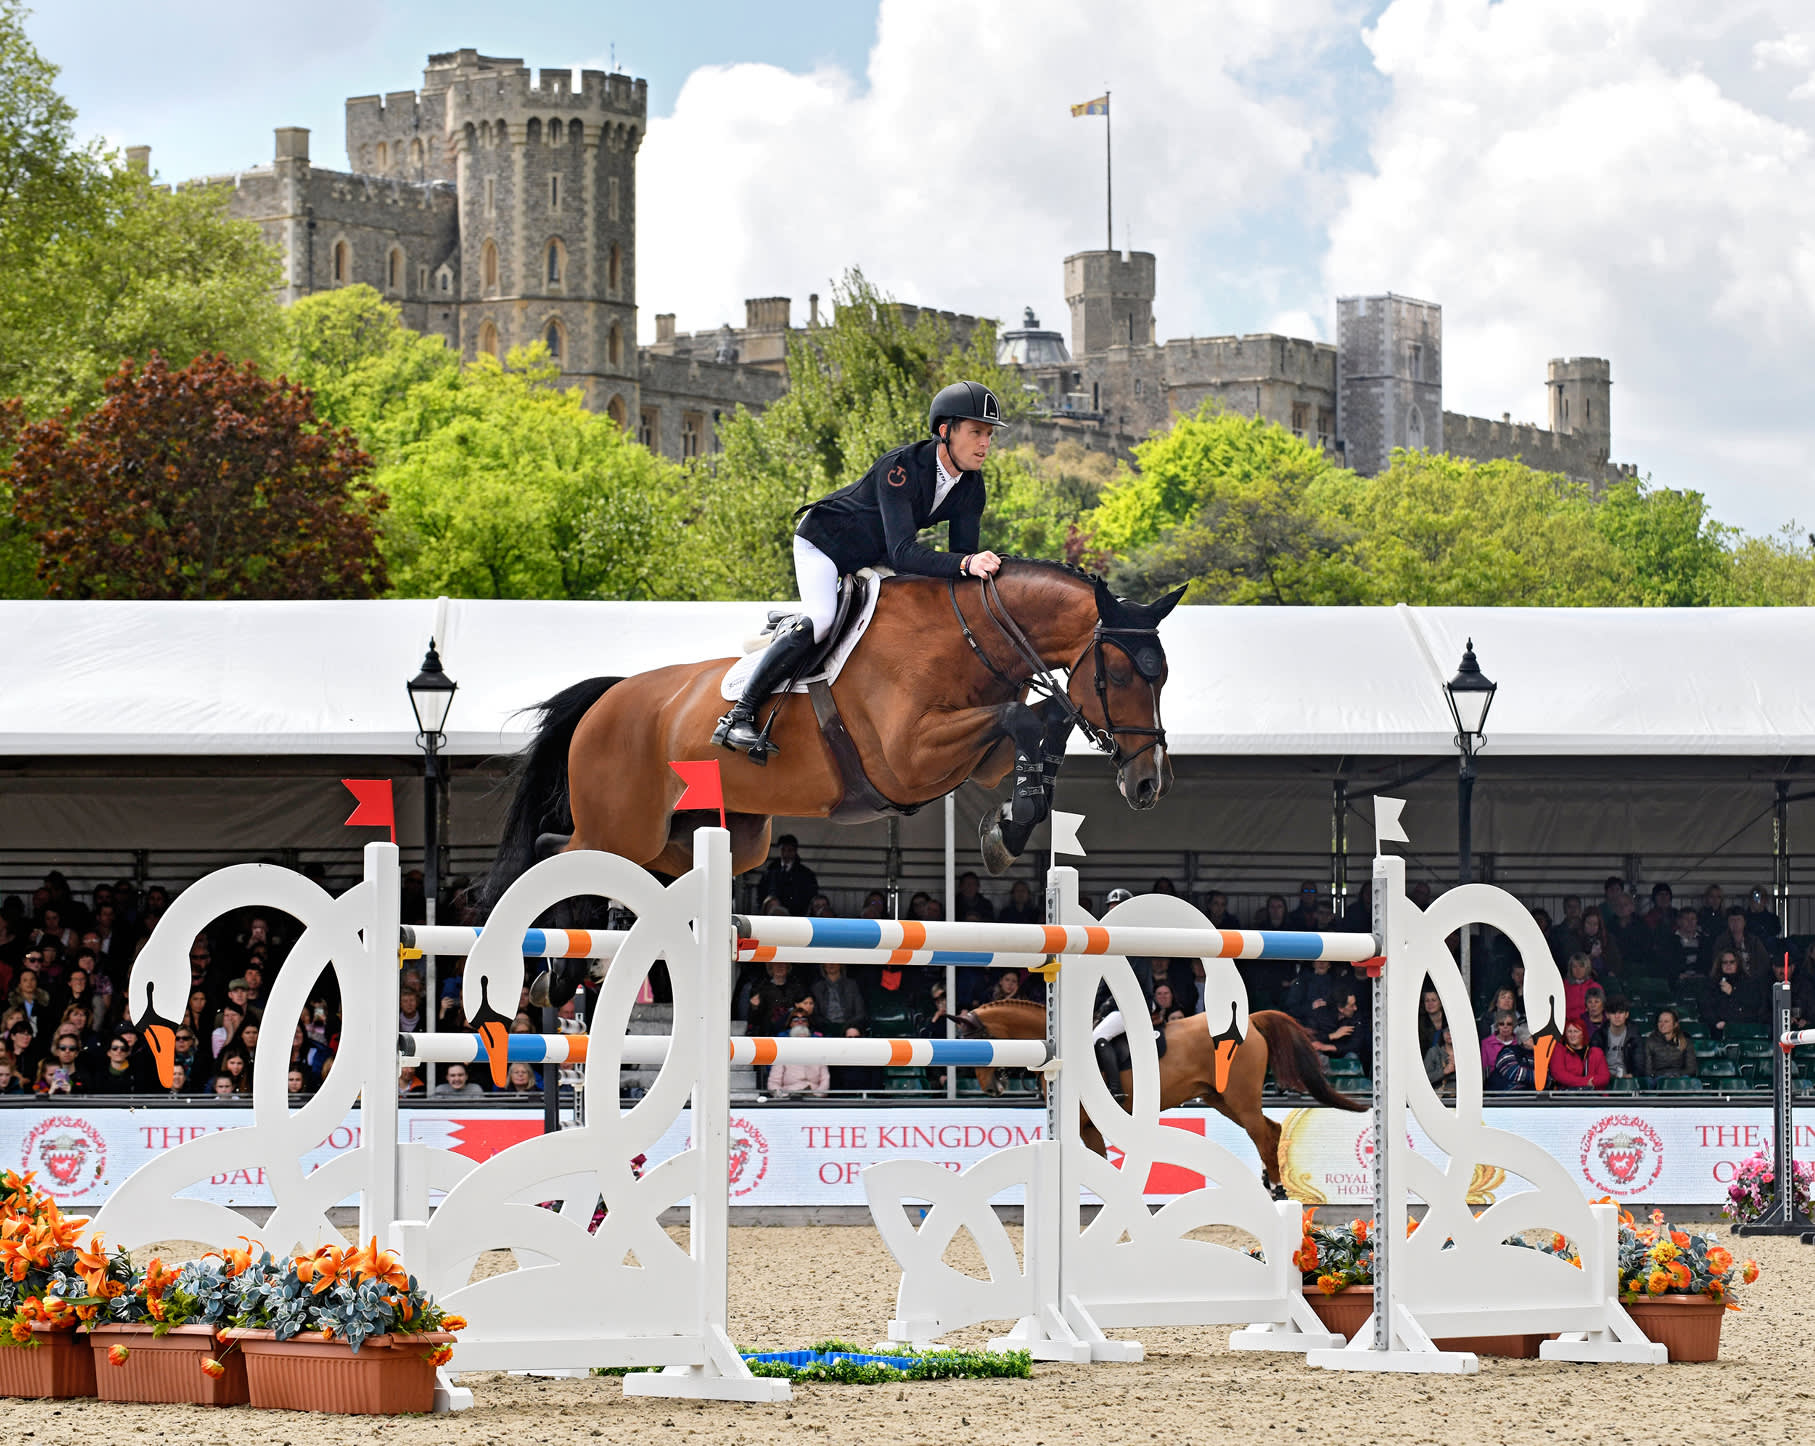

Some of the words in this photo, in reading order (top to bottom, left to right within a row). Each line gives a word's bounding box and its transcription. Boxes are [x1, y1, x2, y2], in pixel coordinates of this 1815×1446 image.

[801, 1126, 867, 1148] THE
[877, 1125, 1043, 1148] KINGDOM
[1695, 1125, 1761, 1147] THE
[818, 1161, 861, 1184] OF
[1325, 1173, 1368, 1184] ROYAL
